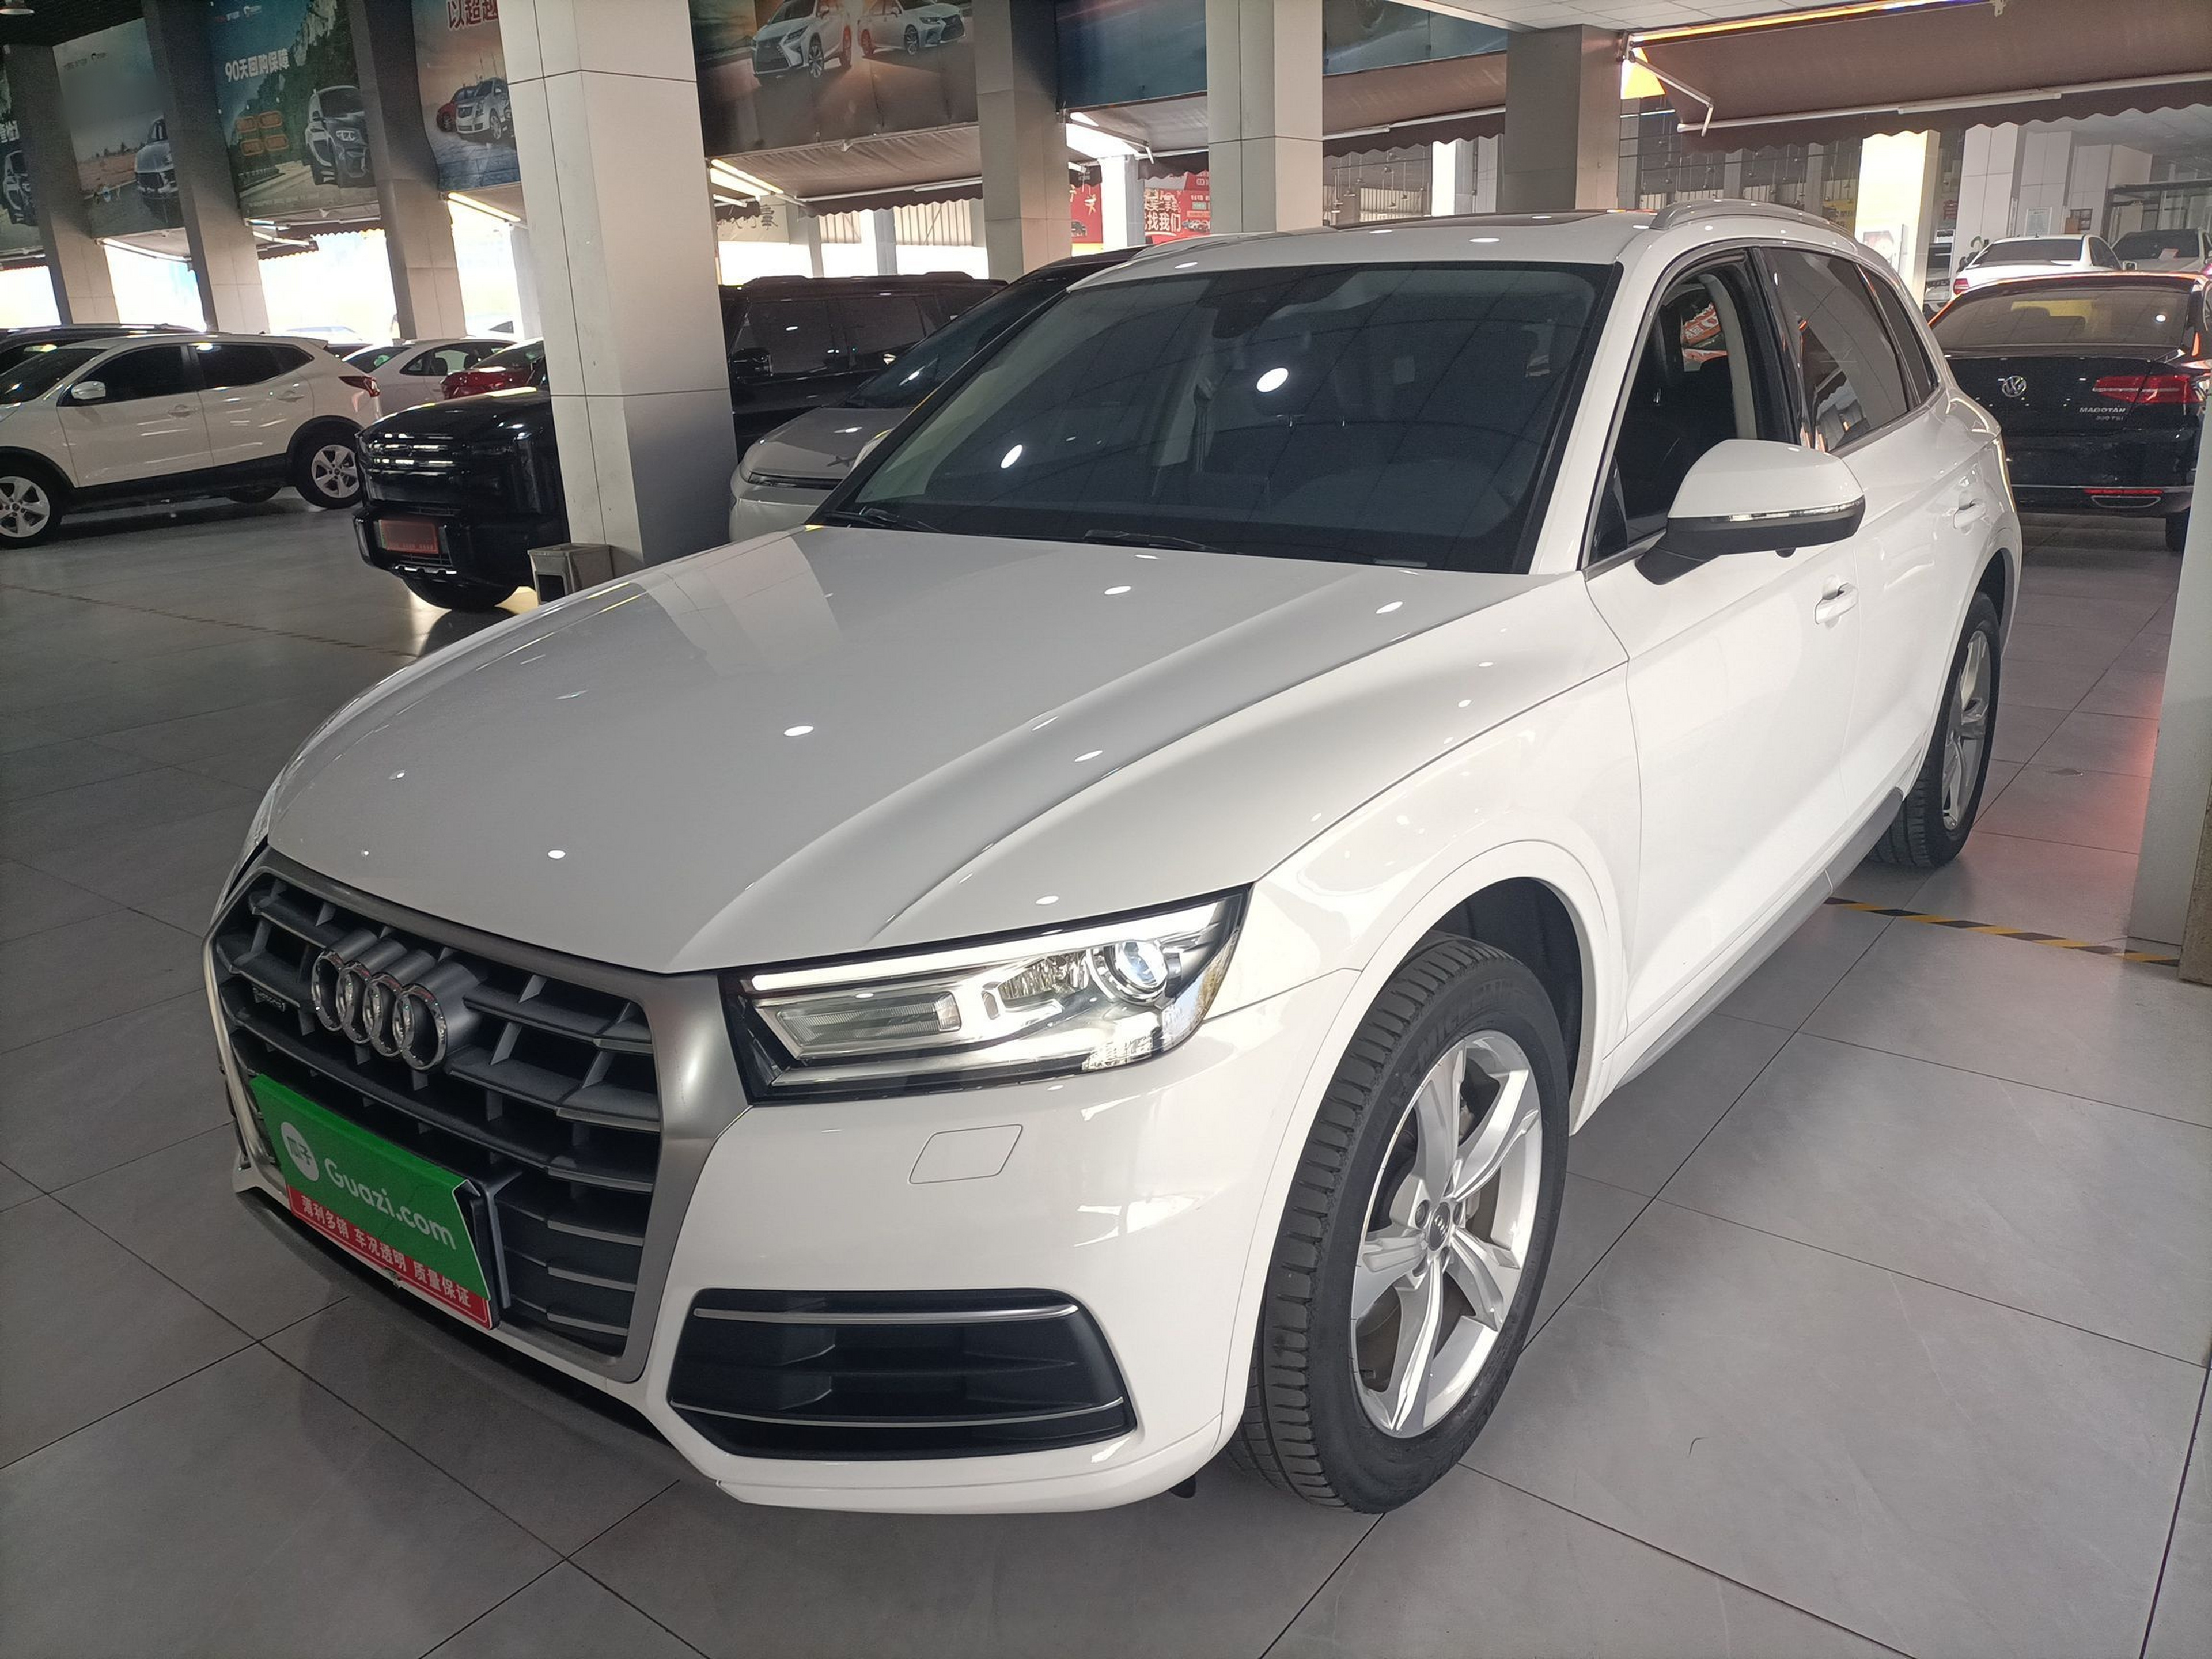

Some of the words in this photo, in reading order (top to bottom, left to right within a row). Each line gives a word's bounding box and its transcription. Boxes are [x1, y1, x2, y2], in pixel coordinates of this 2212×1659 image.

[225, 48, 289, 82] 90天回购保障
[1144, 211, 1181, 232] 找我们
[324, 1158, 456, 1251] Guazi.com
[301, 1195, 349, 1239] 薄利多销
[354, 1228, 407, 1272] 车况透明
[413, 1260, 471, 1308] 质量保证
